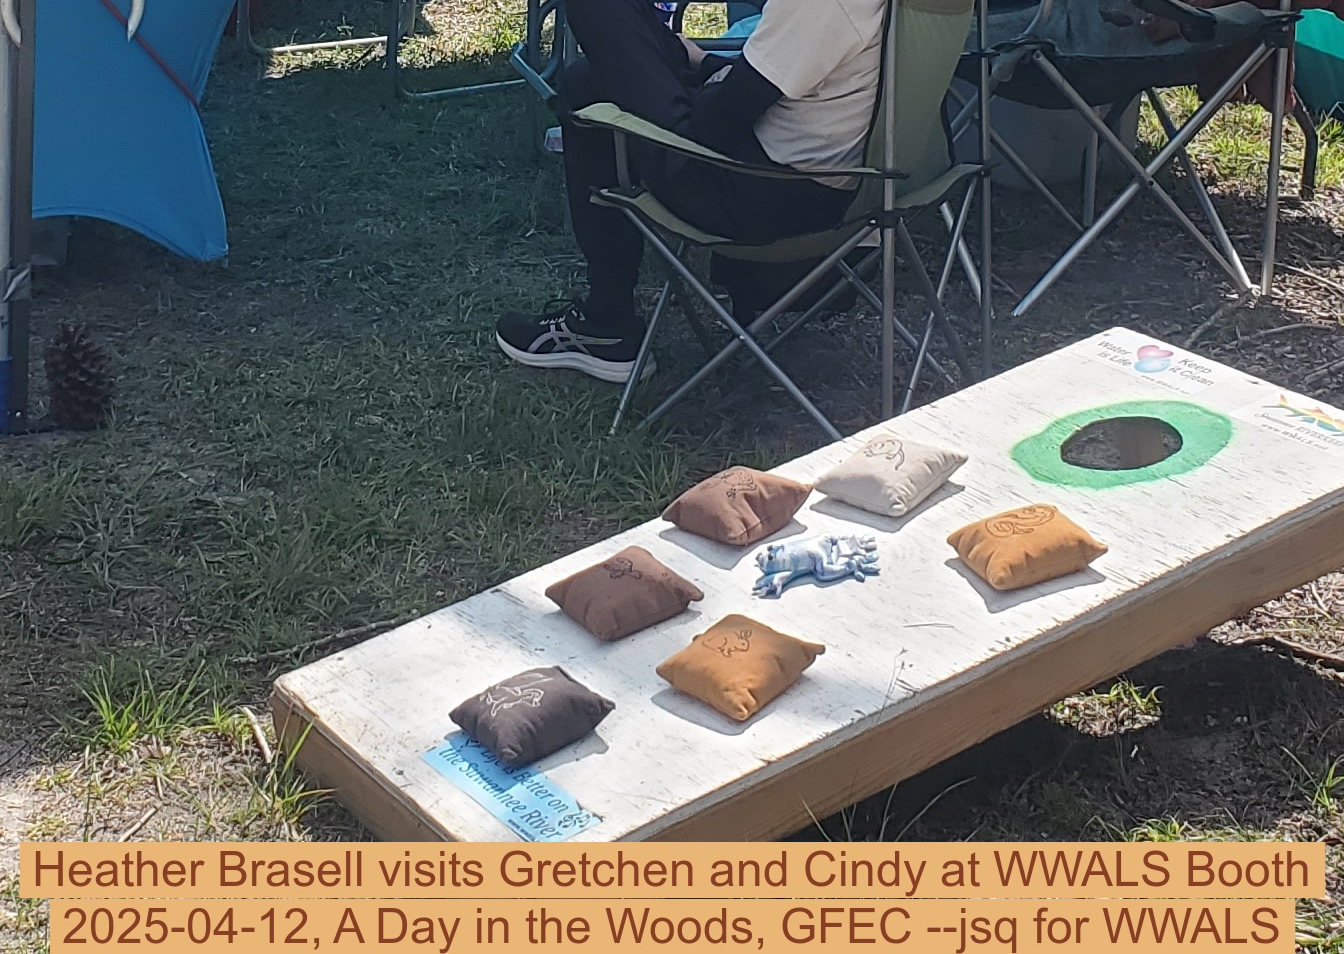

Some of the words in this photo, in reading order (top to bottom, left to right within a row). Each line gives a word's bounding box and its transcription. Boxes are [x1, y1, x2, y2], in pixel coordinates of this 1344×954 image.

[1097, 340, 1134, 356] Water
[1109, 355, 1133, 367] Life
[1178, 358, 1212, 374] Keep
[1180, 370, 1215, 387] Clean
[438, 747, 465, 769] the
[458, 761, 528, 814] Suwannee
[520, 809, 564, 839] River
[512, 770, 555, 800] Better
[547, 796, 569, 814] on
